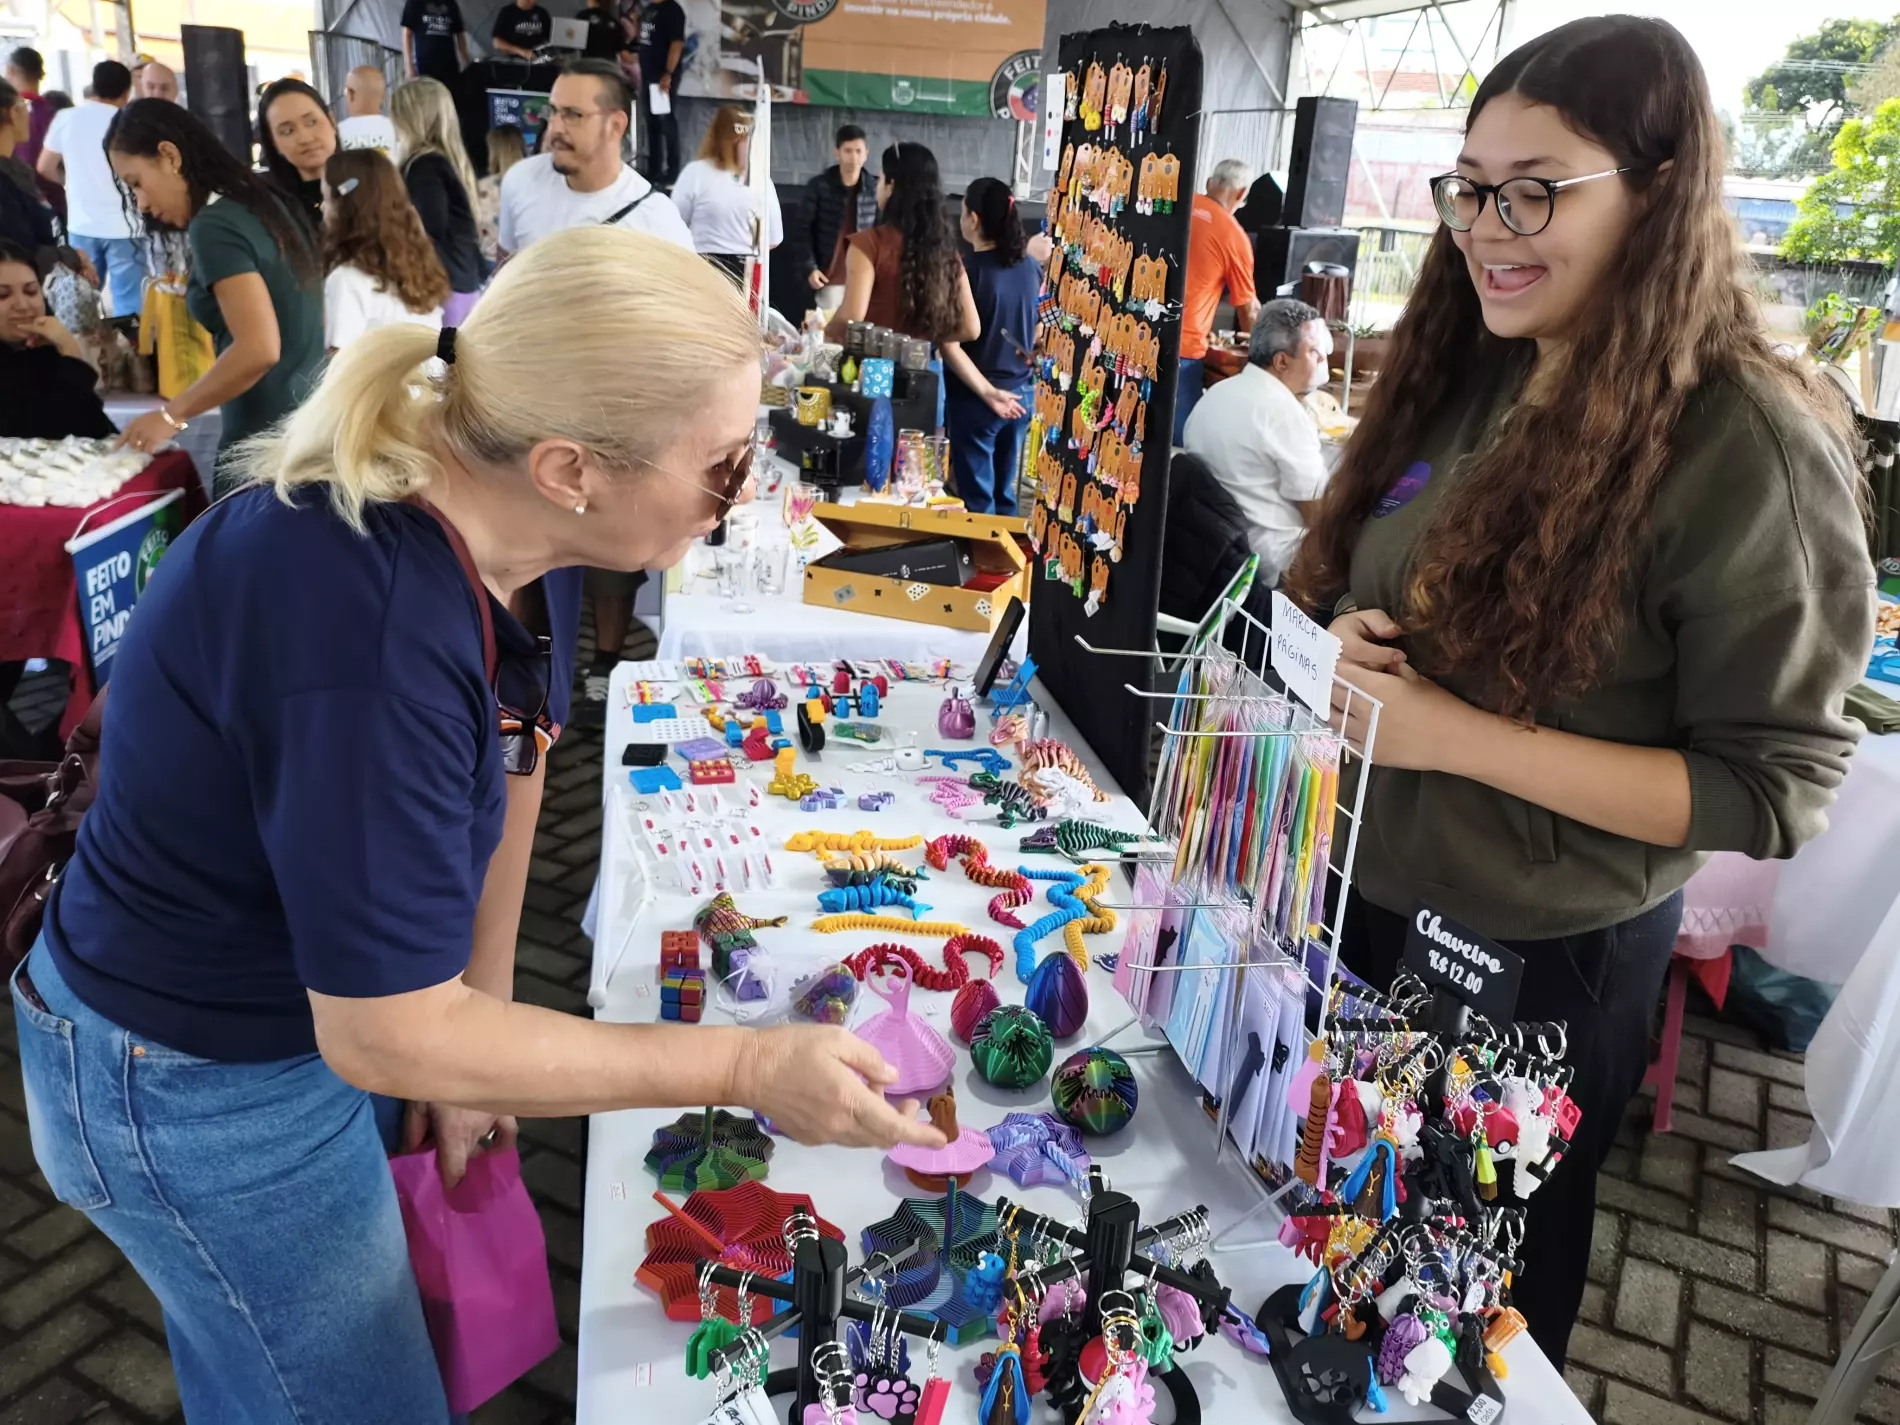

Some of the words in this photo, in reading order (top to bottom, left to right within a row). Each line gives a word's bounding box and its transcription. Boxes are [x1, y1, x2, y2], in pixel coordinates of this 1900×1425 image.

[1003, 55, 1043, 81] FEIT
[86, 550, 131, 597] FEITO
[91, 589, 116, 625] EM
[1282, 602, 1318, 642] MARCA
[93, 603, 136, 654] PIND
[1416, 909, 1505, 974] Chaveiro
[1428, 949, 1449, 974] R$
